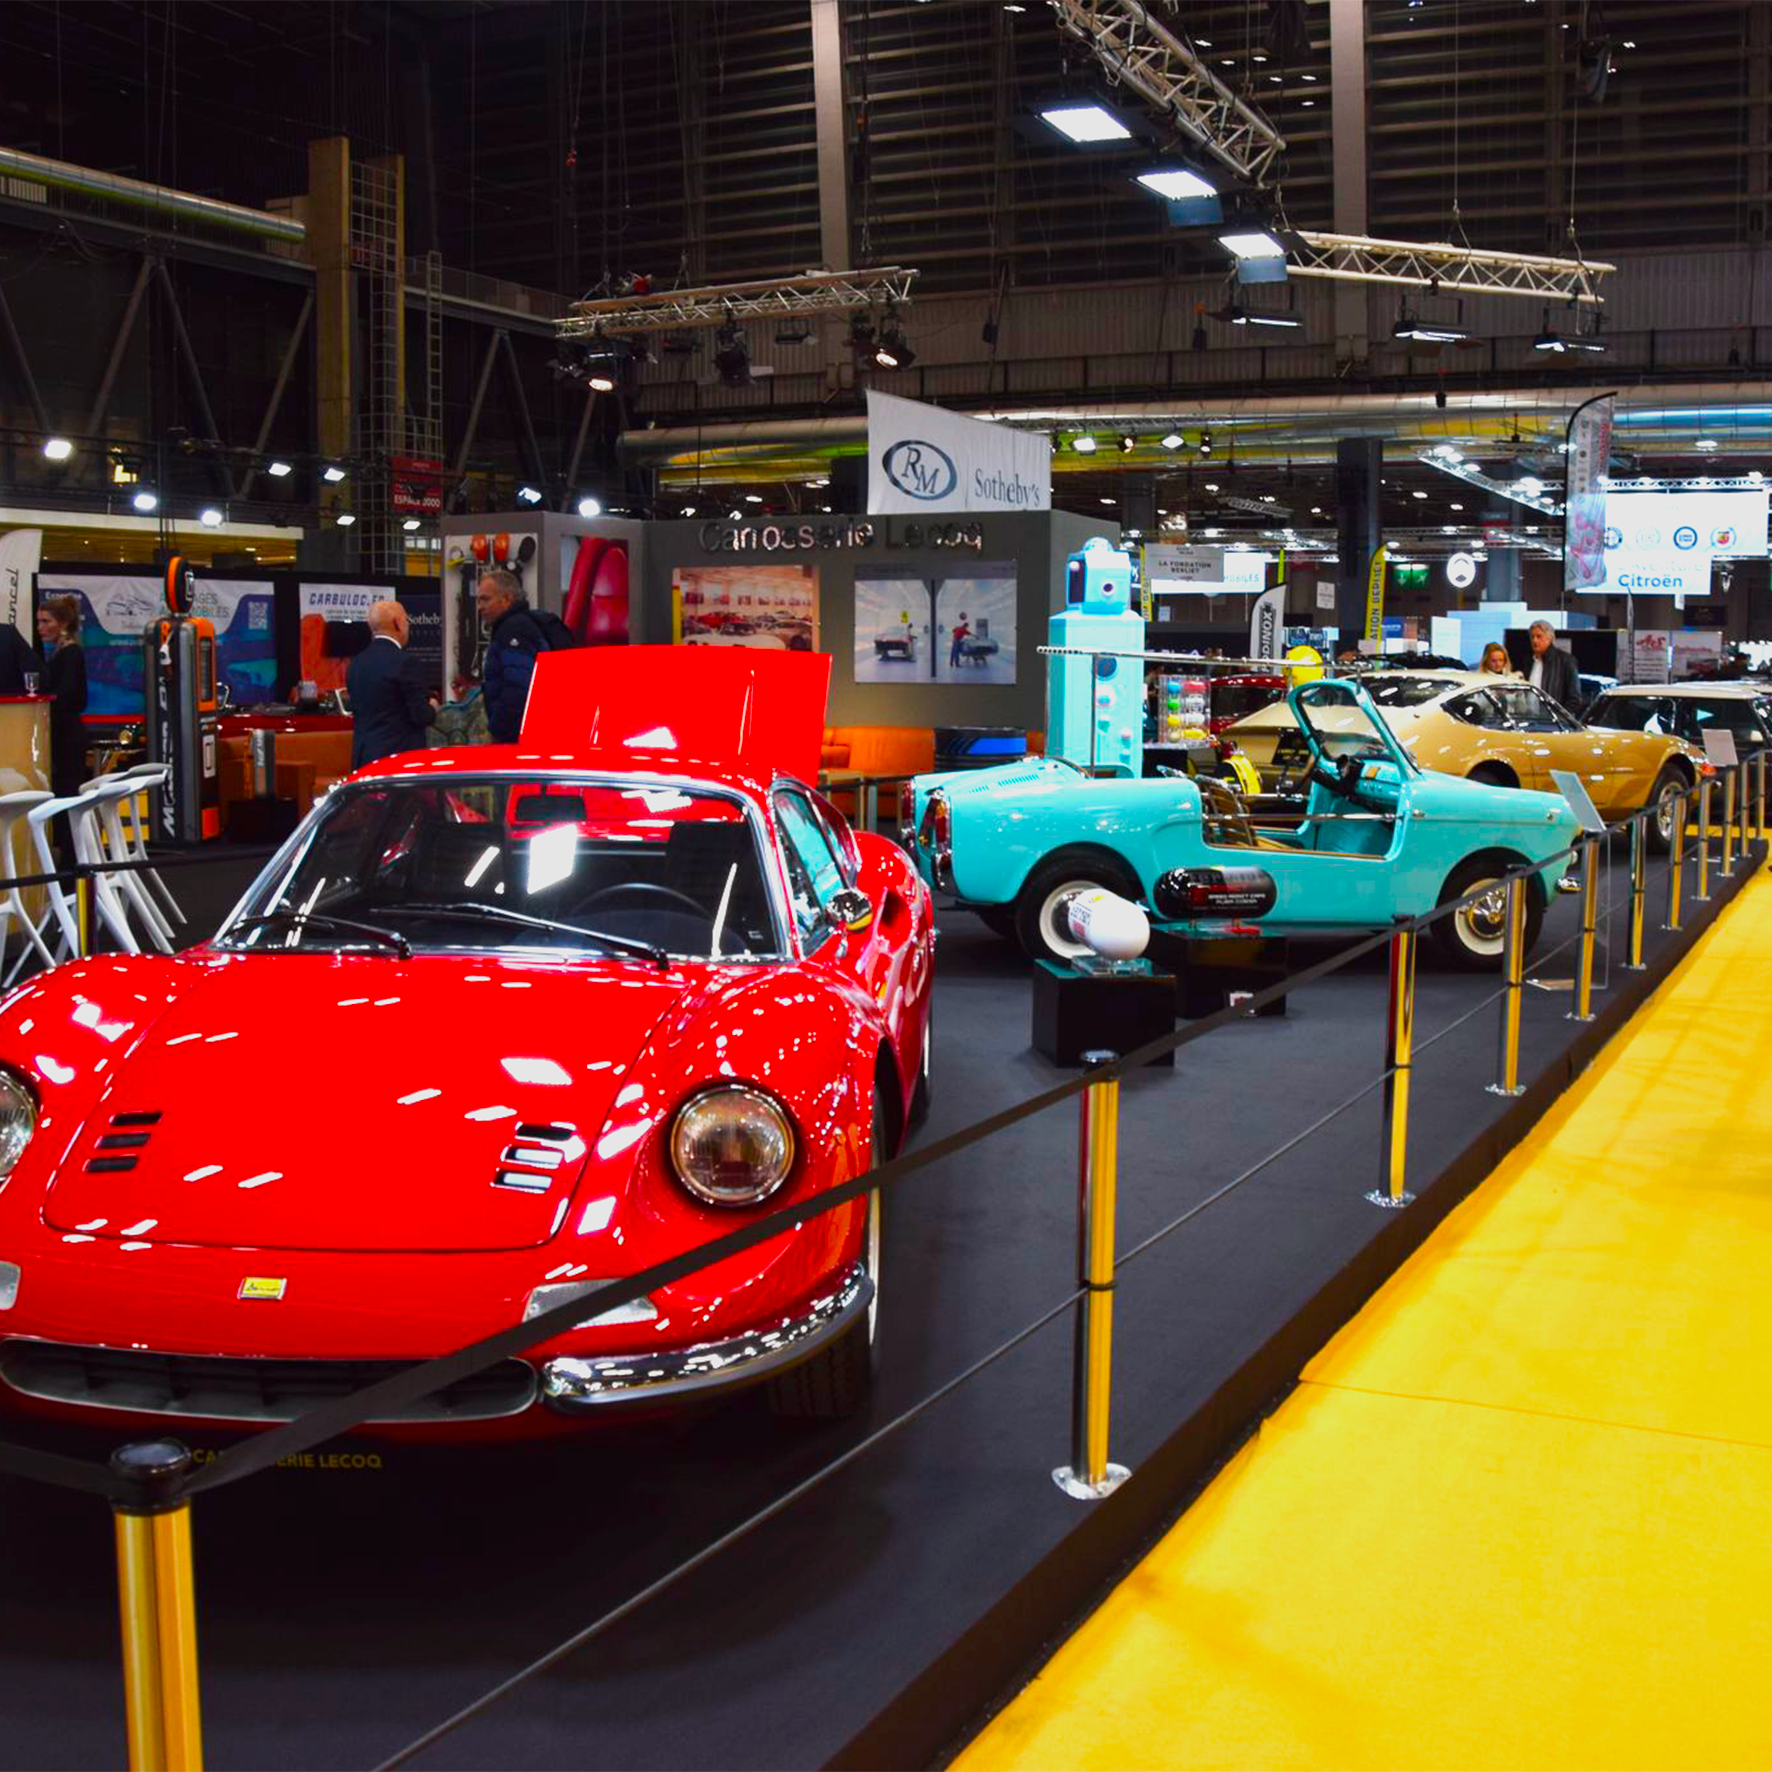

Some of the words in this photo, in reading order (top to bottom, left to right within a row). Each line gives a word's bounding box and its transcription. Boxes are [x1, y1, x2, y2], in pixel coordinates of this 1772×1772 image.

[901, 446, 940, 495] RM
[974, 467, 1041, 507] Sotheby's
[699, 519, 874, 552] Carrosserie
[885, 514, 984, 552] Lecoq
[1618, 574, 1683, 588] Citroën
[407, 612, 442, 627] Sotheb
[319, 1454, 382, 1468] LECOQ
